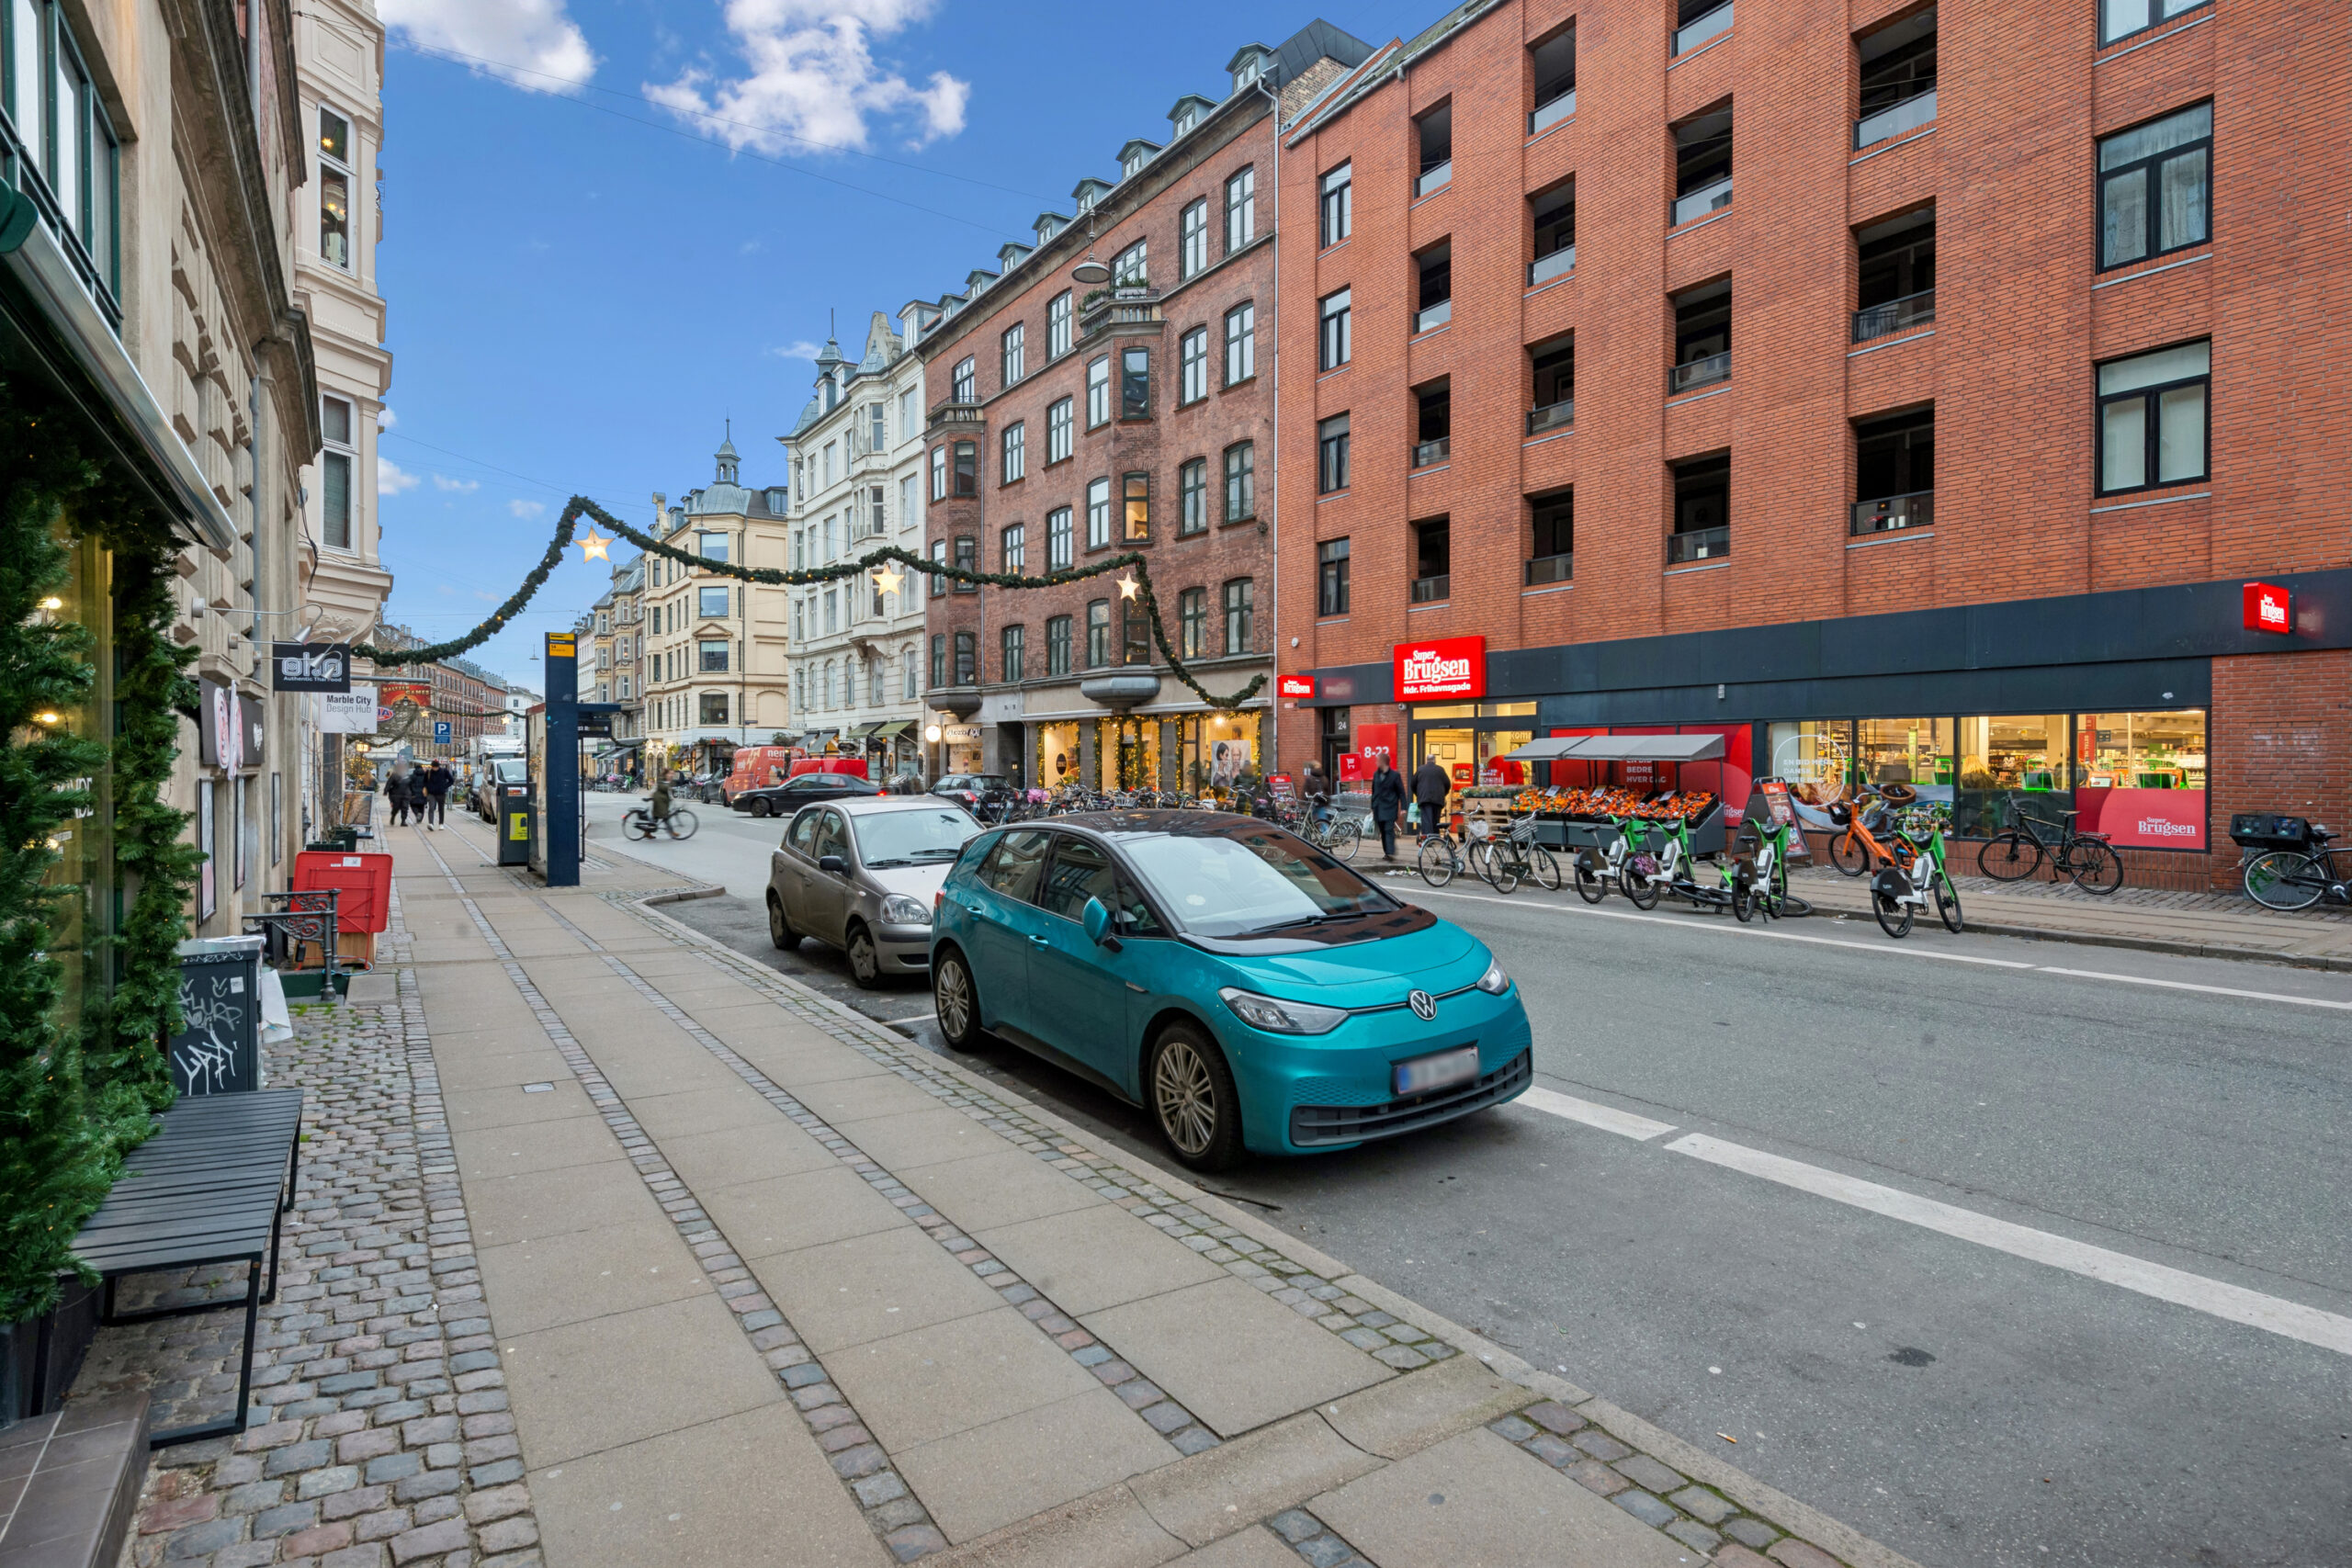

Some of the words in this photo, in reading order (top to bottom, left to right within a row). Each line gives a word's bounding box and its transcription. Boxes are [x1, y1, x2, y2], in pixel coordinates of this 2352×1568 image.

[1412, 649, 1436, 662] Super
[1403, 656, 1470, 683] Brugsen
[1283, 682, 1310, 694] Brugsen
[1403, 686, 1419, 694] Ndr.
[1419, 682, 1471, 694] Frihavnsgade
[326, 694, 355, 704] Marble
[356, 694, 371, 705] City
[326, 705, 354, 714] Design
[356, 705, 371, 714] Hub
[437, 723, 447, 734] P
[1338, 721, 1347, 730] 24
[1364, 746, 1389, 759] 8-22
[1724, 807, 1746, 818] ugse
[2138, 820, 2196, 836] Brugsen
